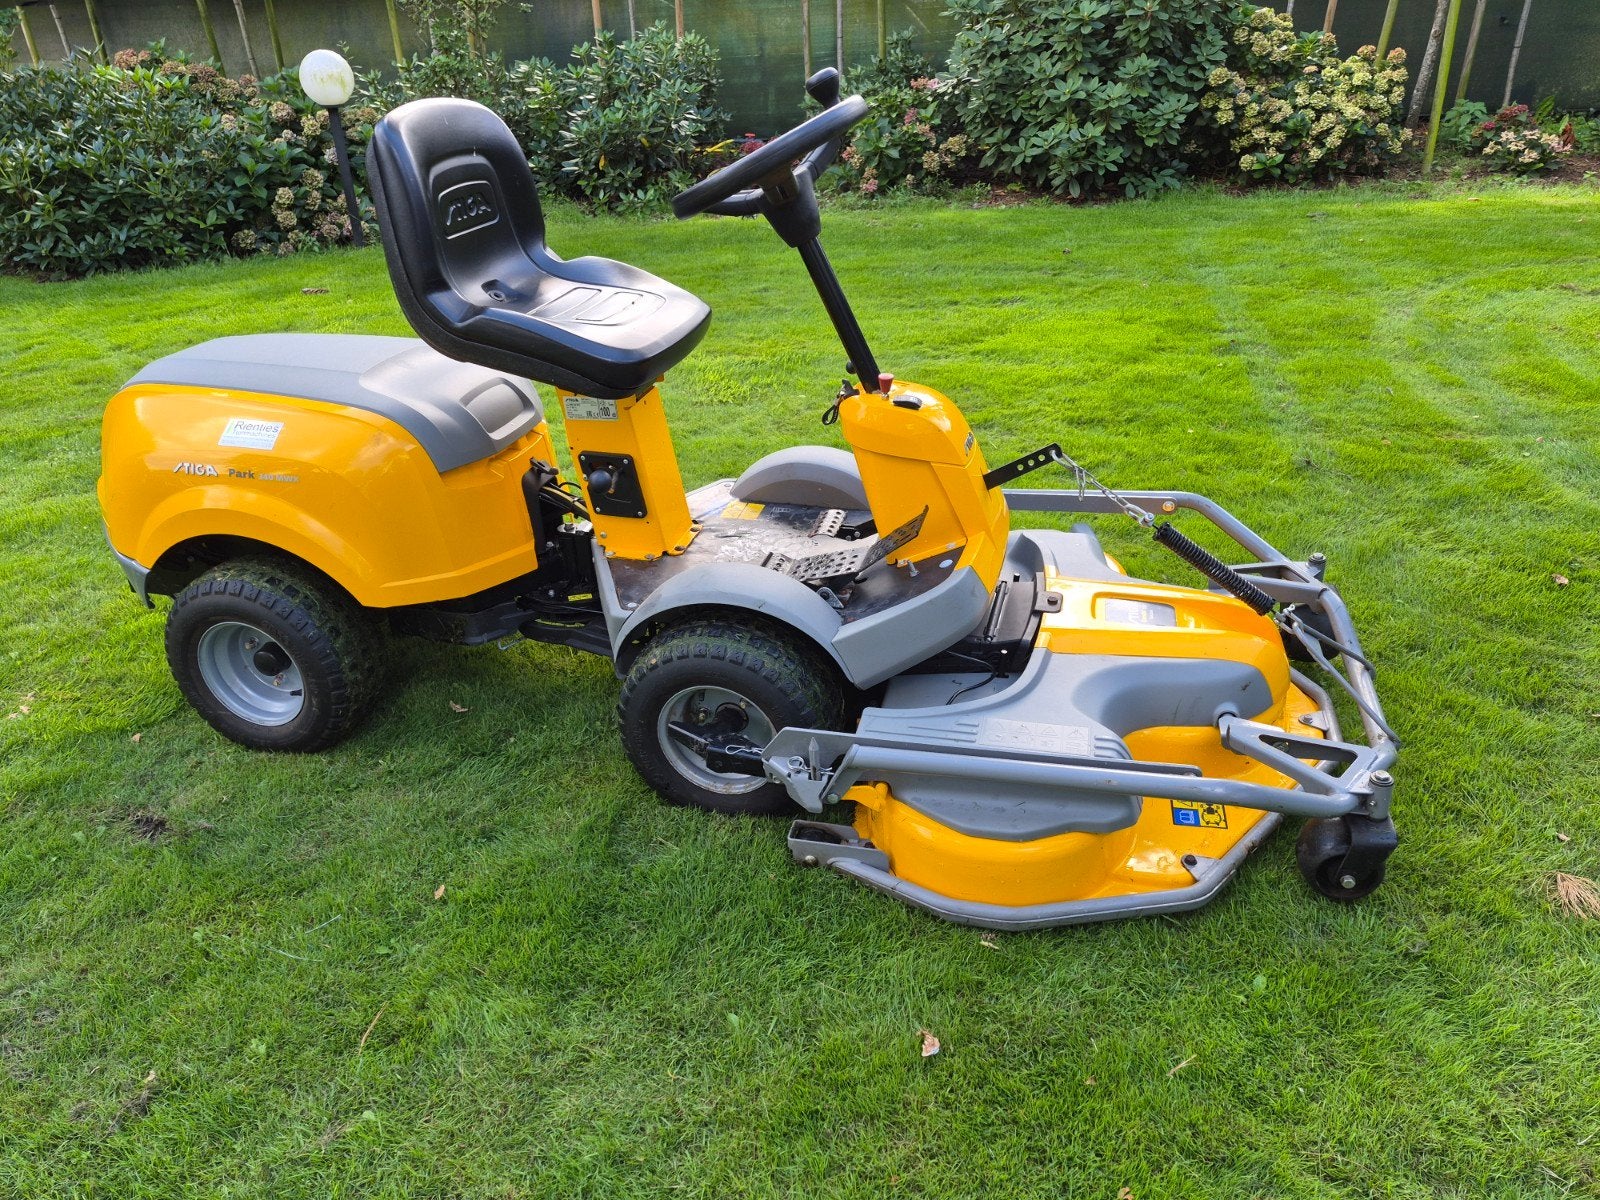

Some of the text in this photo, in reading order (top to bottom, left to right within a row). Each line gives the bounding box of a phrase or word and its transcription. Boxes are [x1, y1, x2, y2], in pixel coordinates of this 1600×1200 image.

[447, 196, 491, 226] STIGA
[173, 462, 218, 477] STIGA
[228, 468, 255, 479] Park
